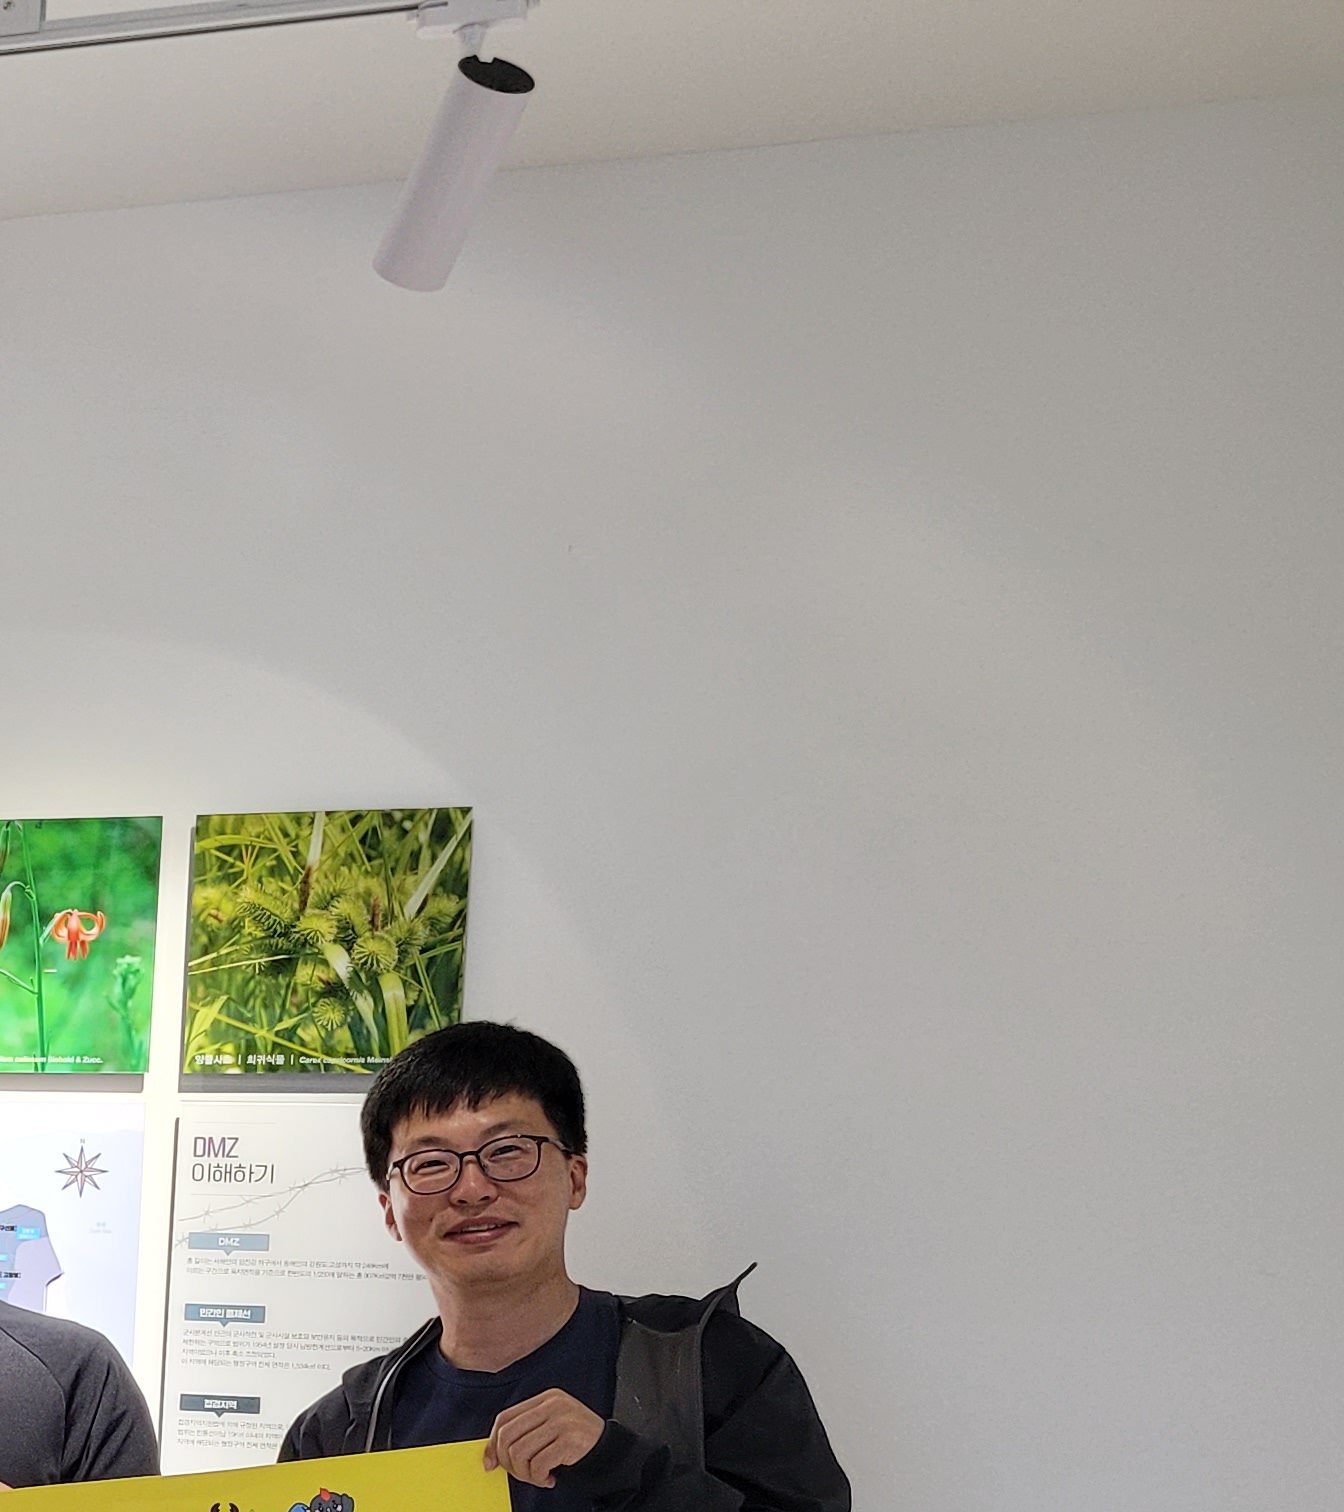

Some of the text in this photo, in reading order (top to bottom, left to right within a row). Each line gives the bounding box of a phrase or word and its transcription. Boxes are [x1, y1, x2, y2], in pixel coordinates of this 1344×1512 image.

[193, 1137, 239, 1158] DMZ
[192, 1163, 275, 1184] 이해하기
[219, 1238, 239, 1246] DMZ
